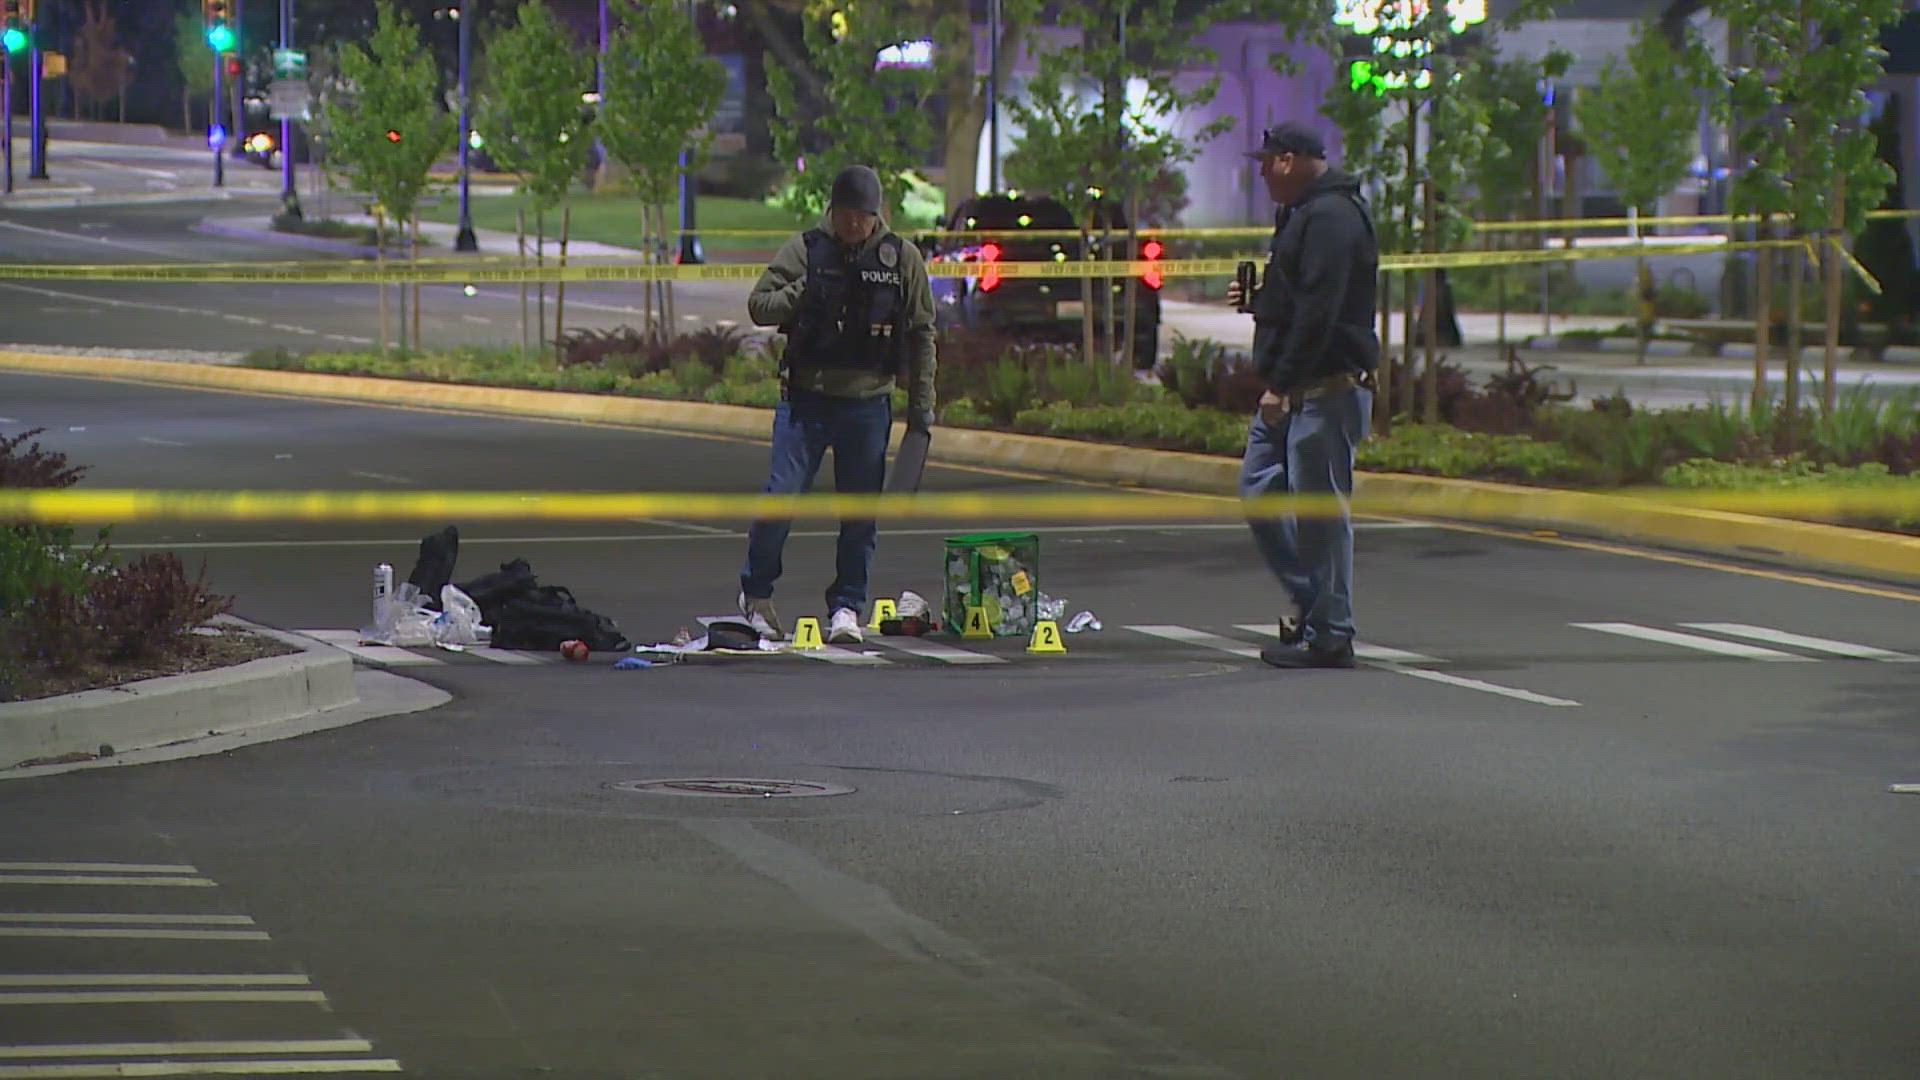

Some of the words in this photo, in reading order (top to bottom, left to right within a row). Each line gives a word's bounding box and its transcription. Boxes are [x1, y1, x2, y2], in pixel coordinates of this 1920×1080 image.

[861, 270, 900, 285] POLICE
[971, 612, 981, 630] 4
[803, 624, 814, 642] 7
[1043, 626, 1053, 644] 2
